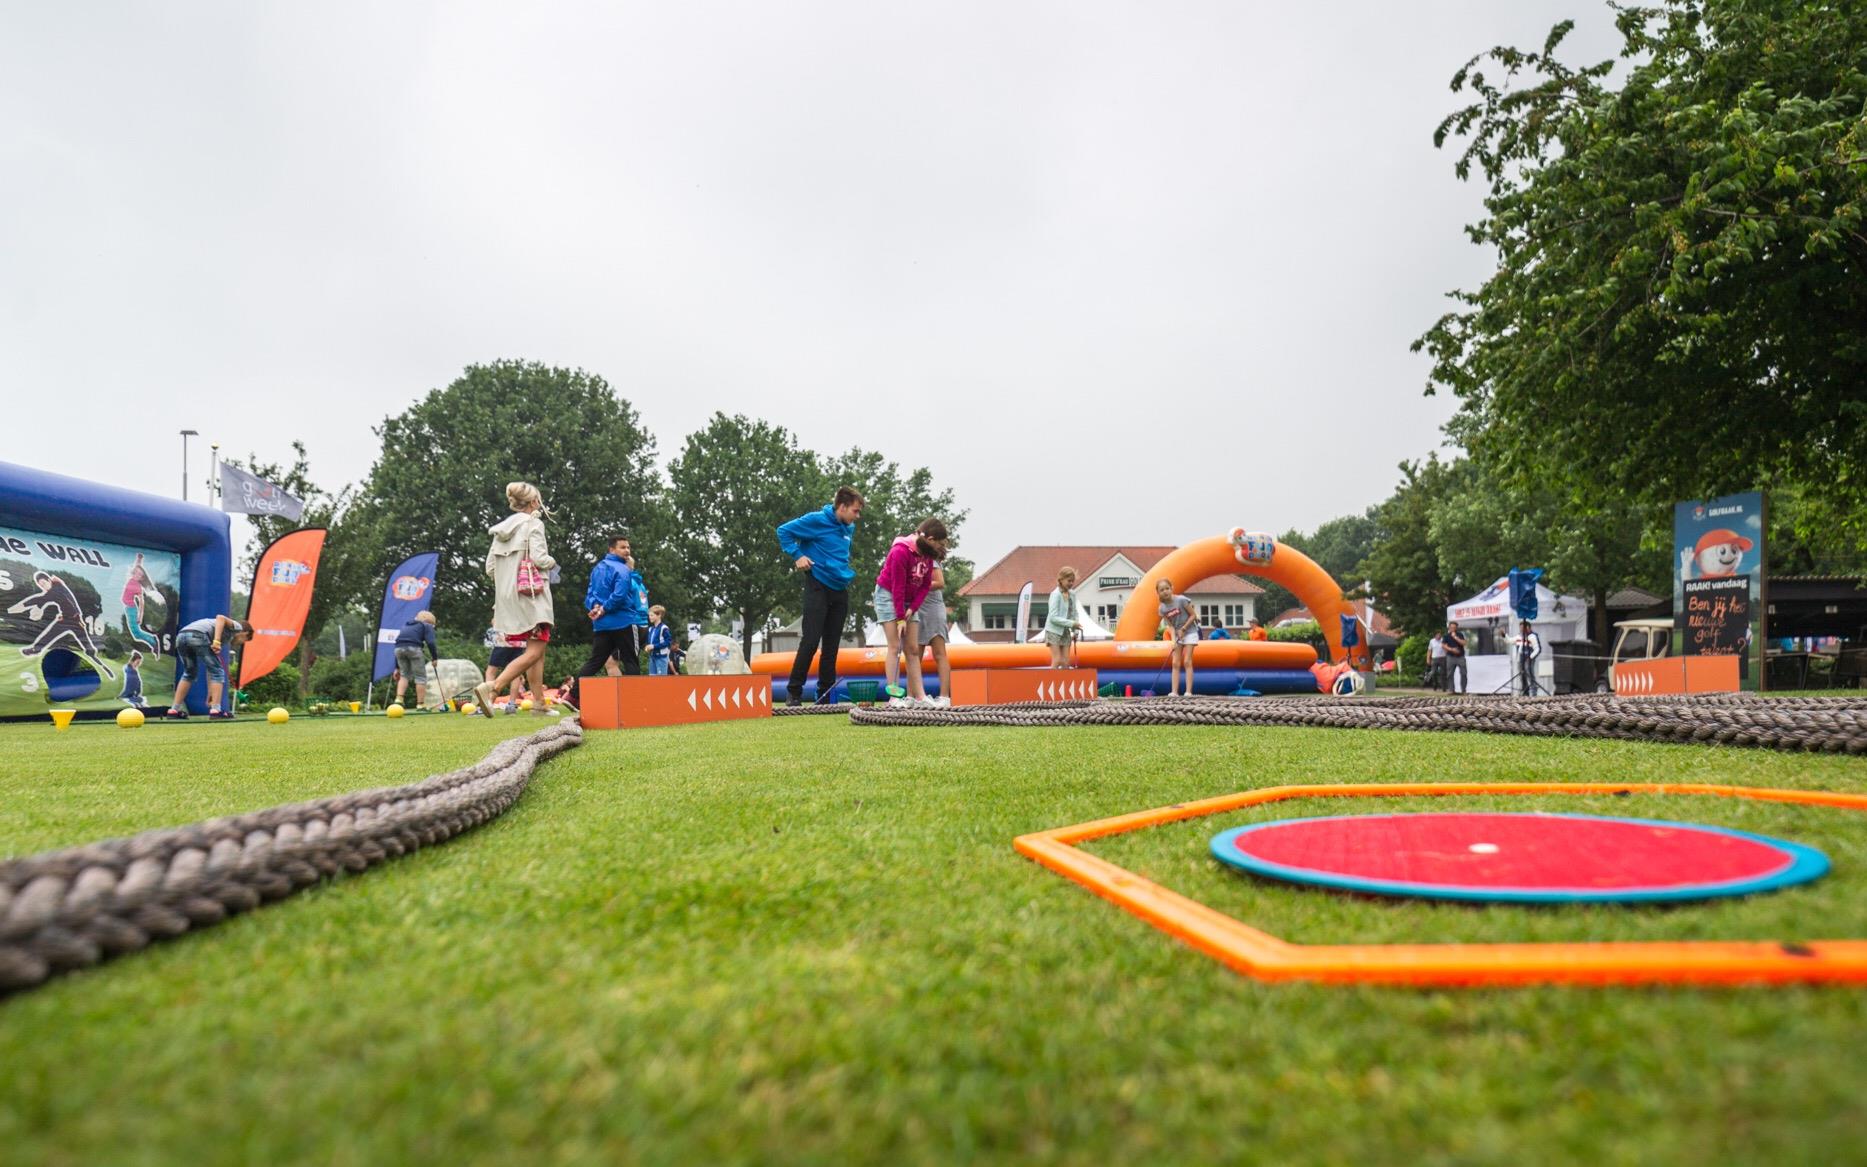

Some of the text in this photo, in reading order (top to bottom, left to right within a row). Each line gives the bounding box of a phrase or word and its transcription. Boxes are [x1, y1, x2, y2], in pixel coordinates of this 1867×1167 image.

[37, 541, 111, 568] WALL
[1686, 579, 1747, 592] RAAK! vandaag
[1688, 596, 1710, 611] Ben
[1711, 595, 1726, 618] jij
[20, 672, 39, 693] 3
